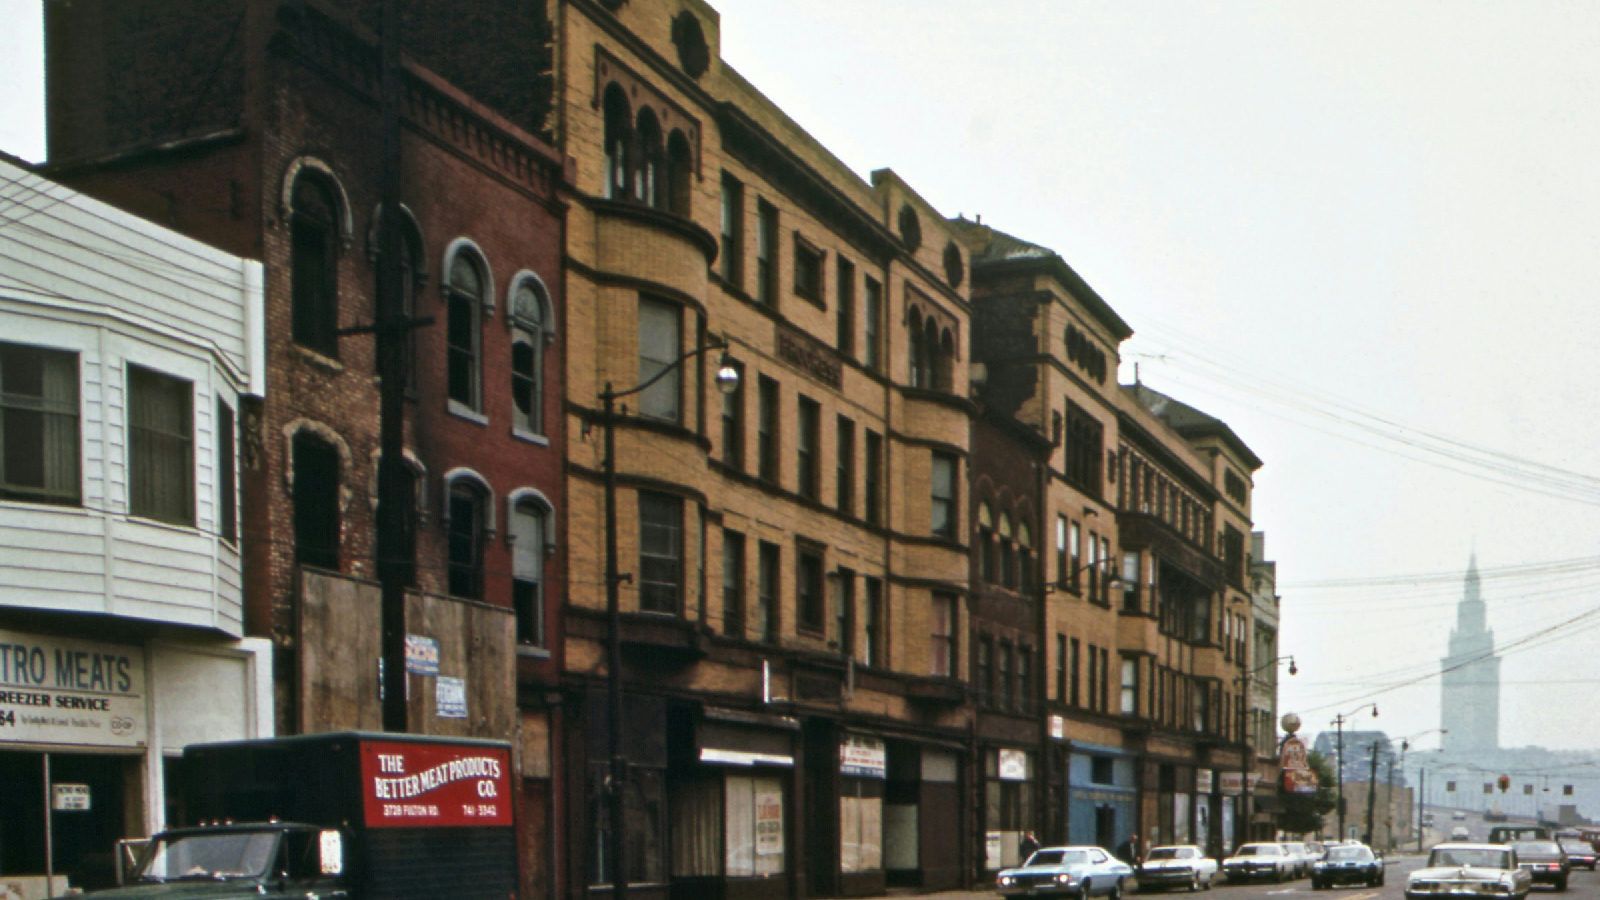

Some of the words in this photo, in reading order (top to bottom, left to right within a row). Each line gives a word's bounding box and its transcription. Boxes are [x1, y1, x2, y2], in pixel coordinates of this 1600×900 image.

[55, 648, 131, 692] MEATS
[56, 695, 110, 711] SERVICE
[378, 754, 404, 773] THE
[374, 775, 420, 799] BETTER
[420, 763, 449, 793] MEAT
[449, 756, 500, 781] PRODUCTS
[477, 780, 497, 798] CO.
